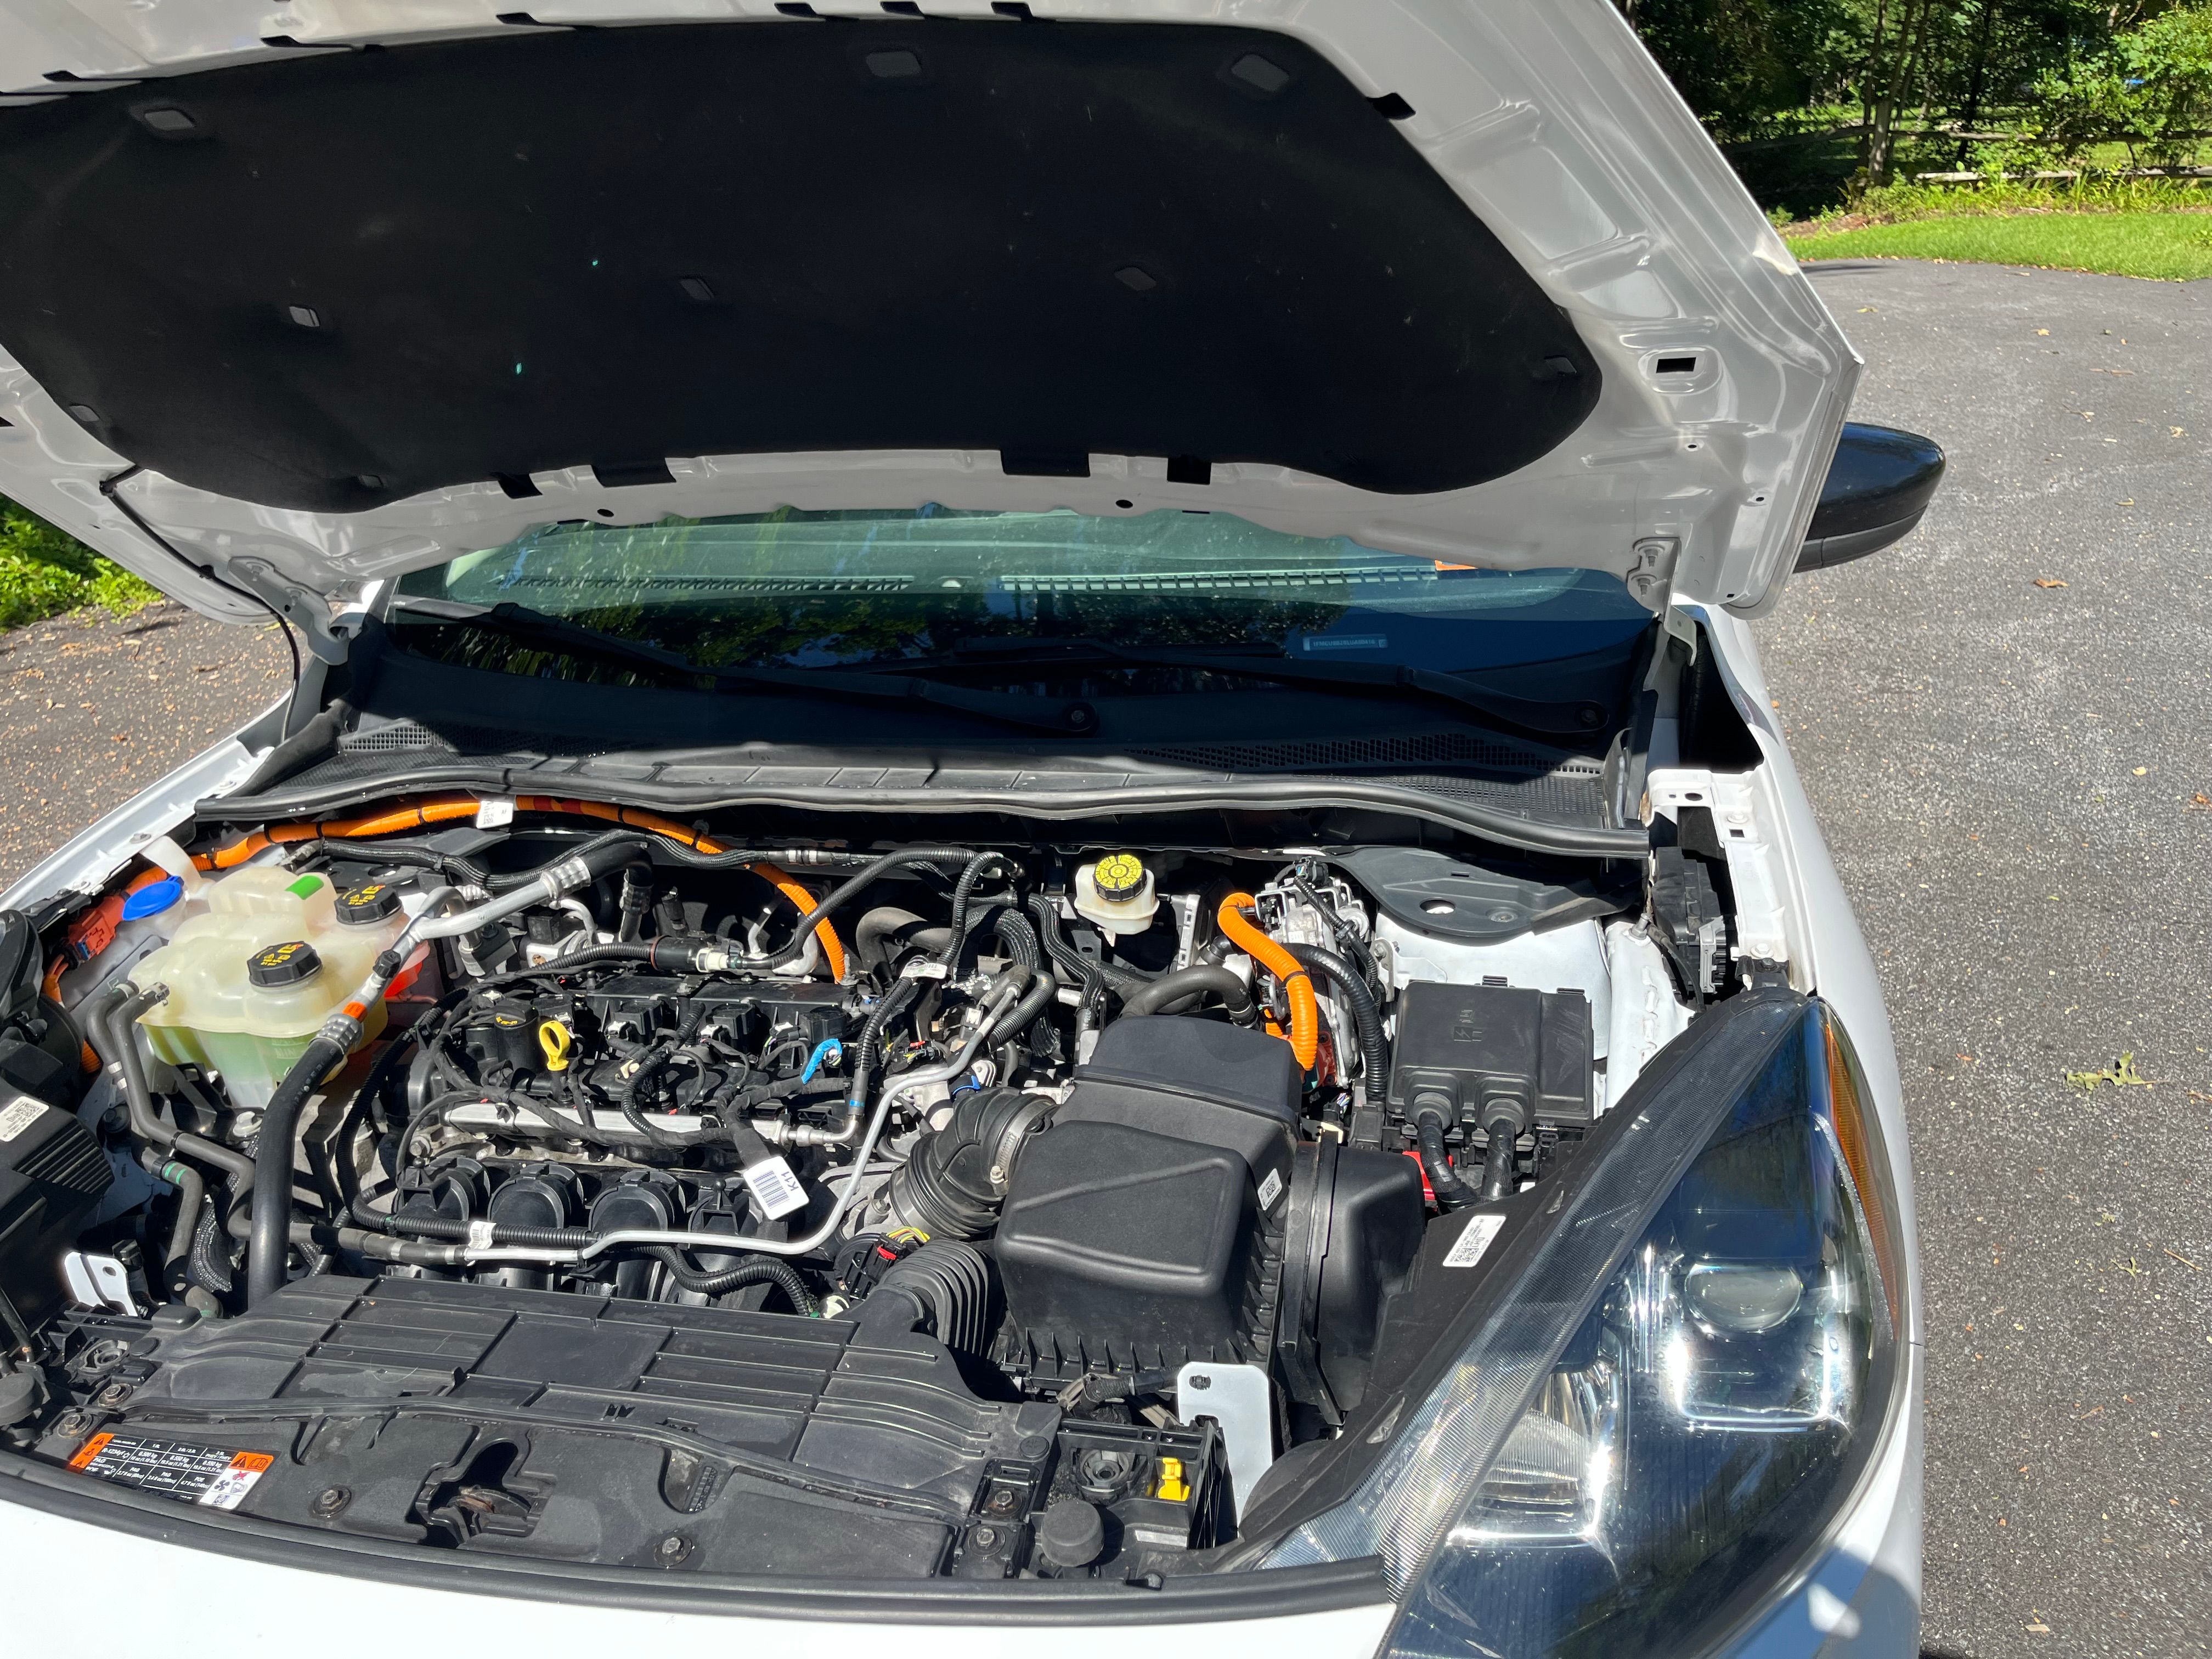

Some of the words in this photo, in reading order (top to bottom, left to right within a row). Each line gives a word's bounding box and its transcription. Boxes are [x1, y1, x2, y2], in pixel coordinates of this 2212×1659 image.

[6, 1113, 20, 1122] RHD
[781, 1171, 799, 1192] K11
[1472, 1237, 1486, 1248] LHD
[101, 1448, 125, 1456] R-1234yf
